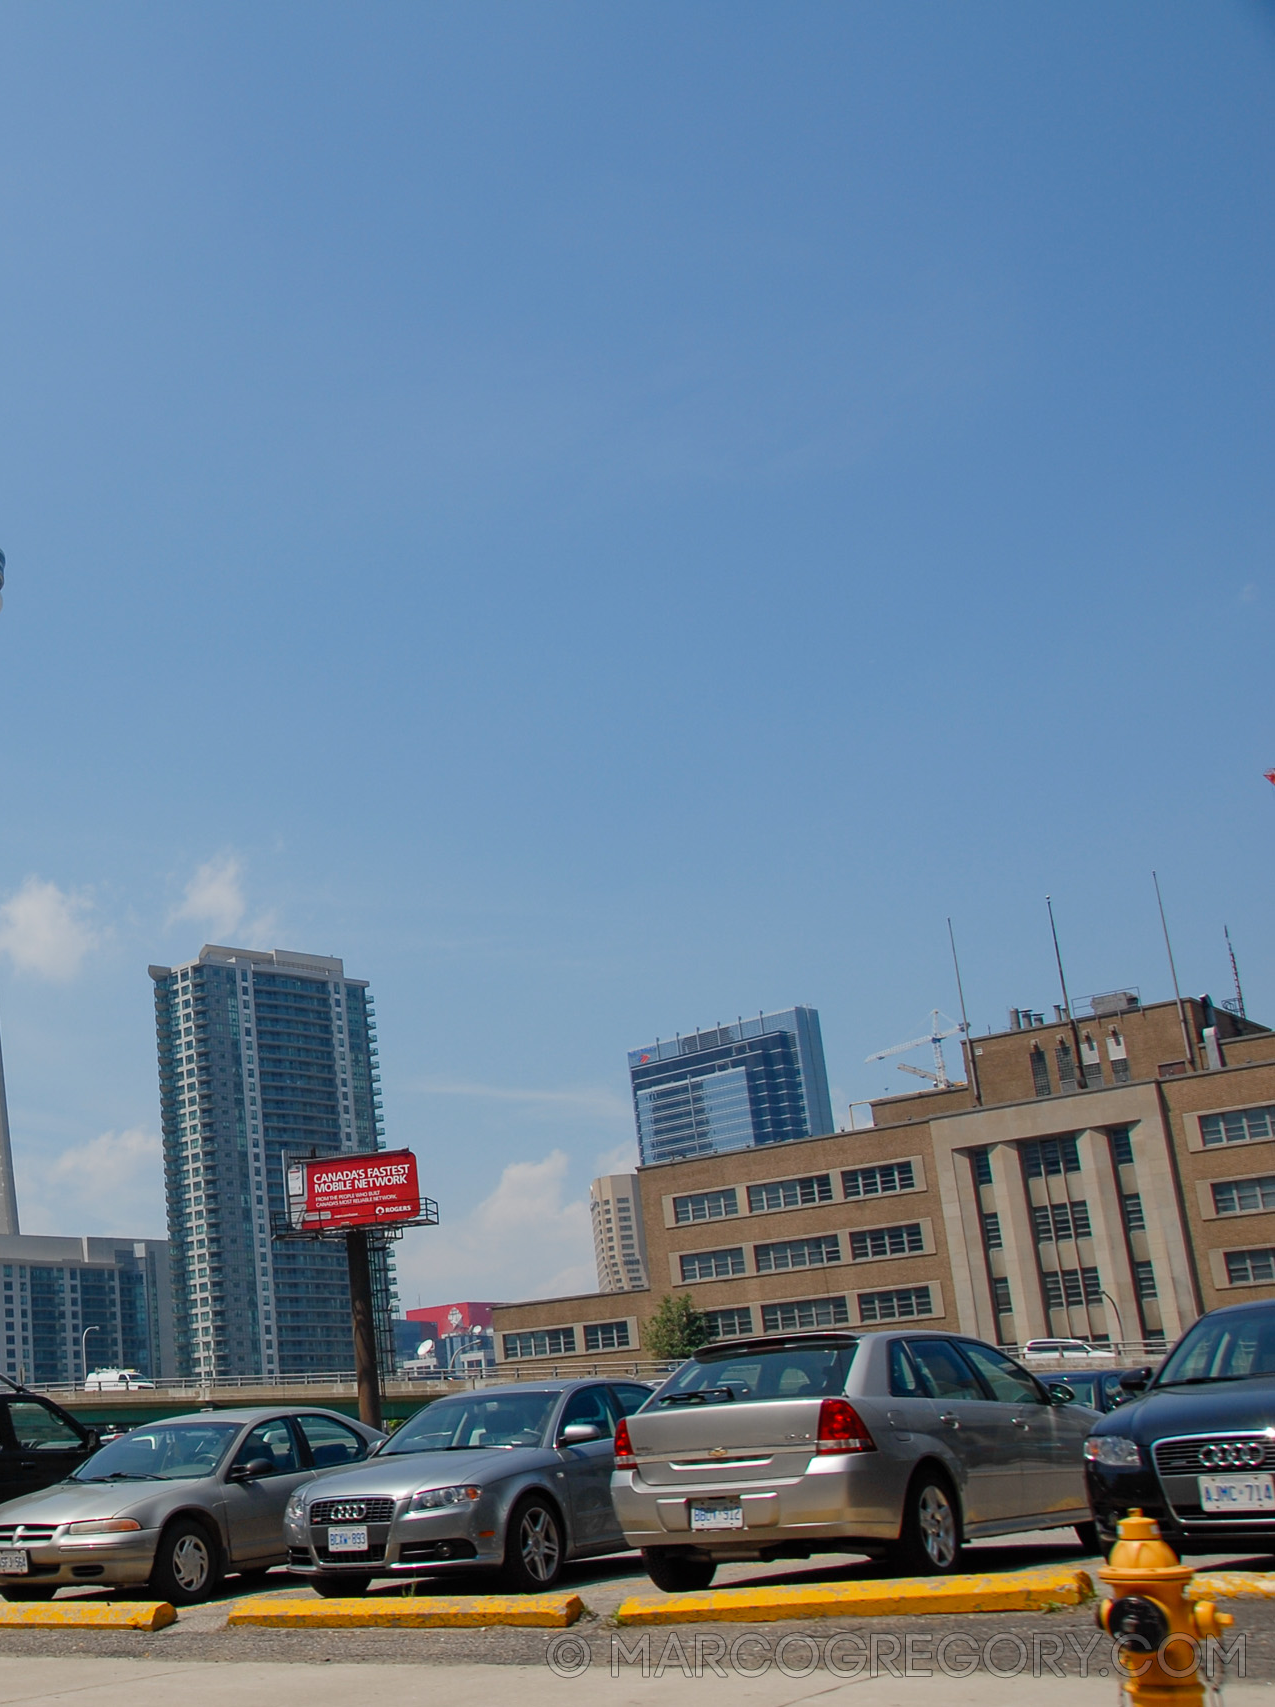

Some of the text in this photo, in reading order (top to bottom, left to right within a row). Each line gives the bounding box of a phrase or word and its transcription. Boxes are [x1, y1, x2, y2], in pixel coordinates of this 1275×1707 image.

[313, 1164, 410, 1184] CANADA'S FASTEST
[314, 1174, 407, 1193] MOBILE NETWORK
[385, 1204, 412, 1213] ROGERS
[1244, 1483, 1273, 1501] 714
